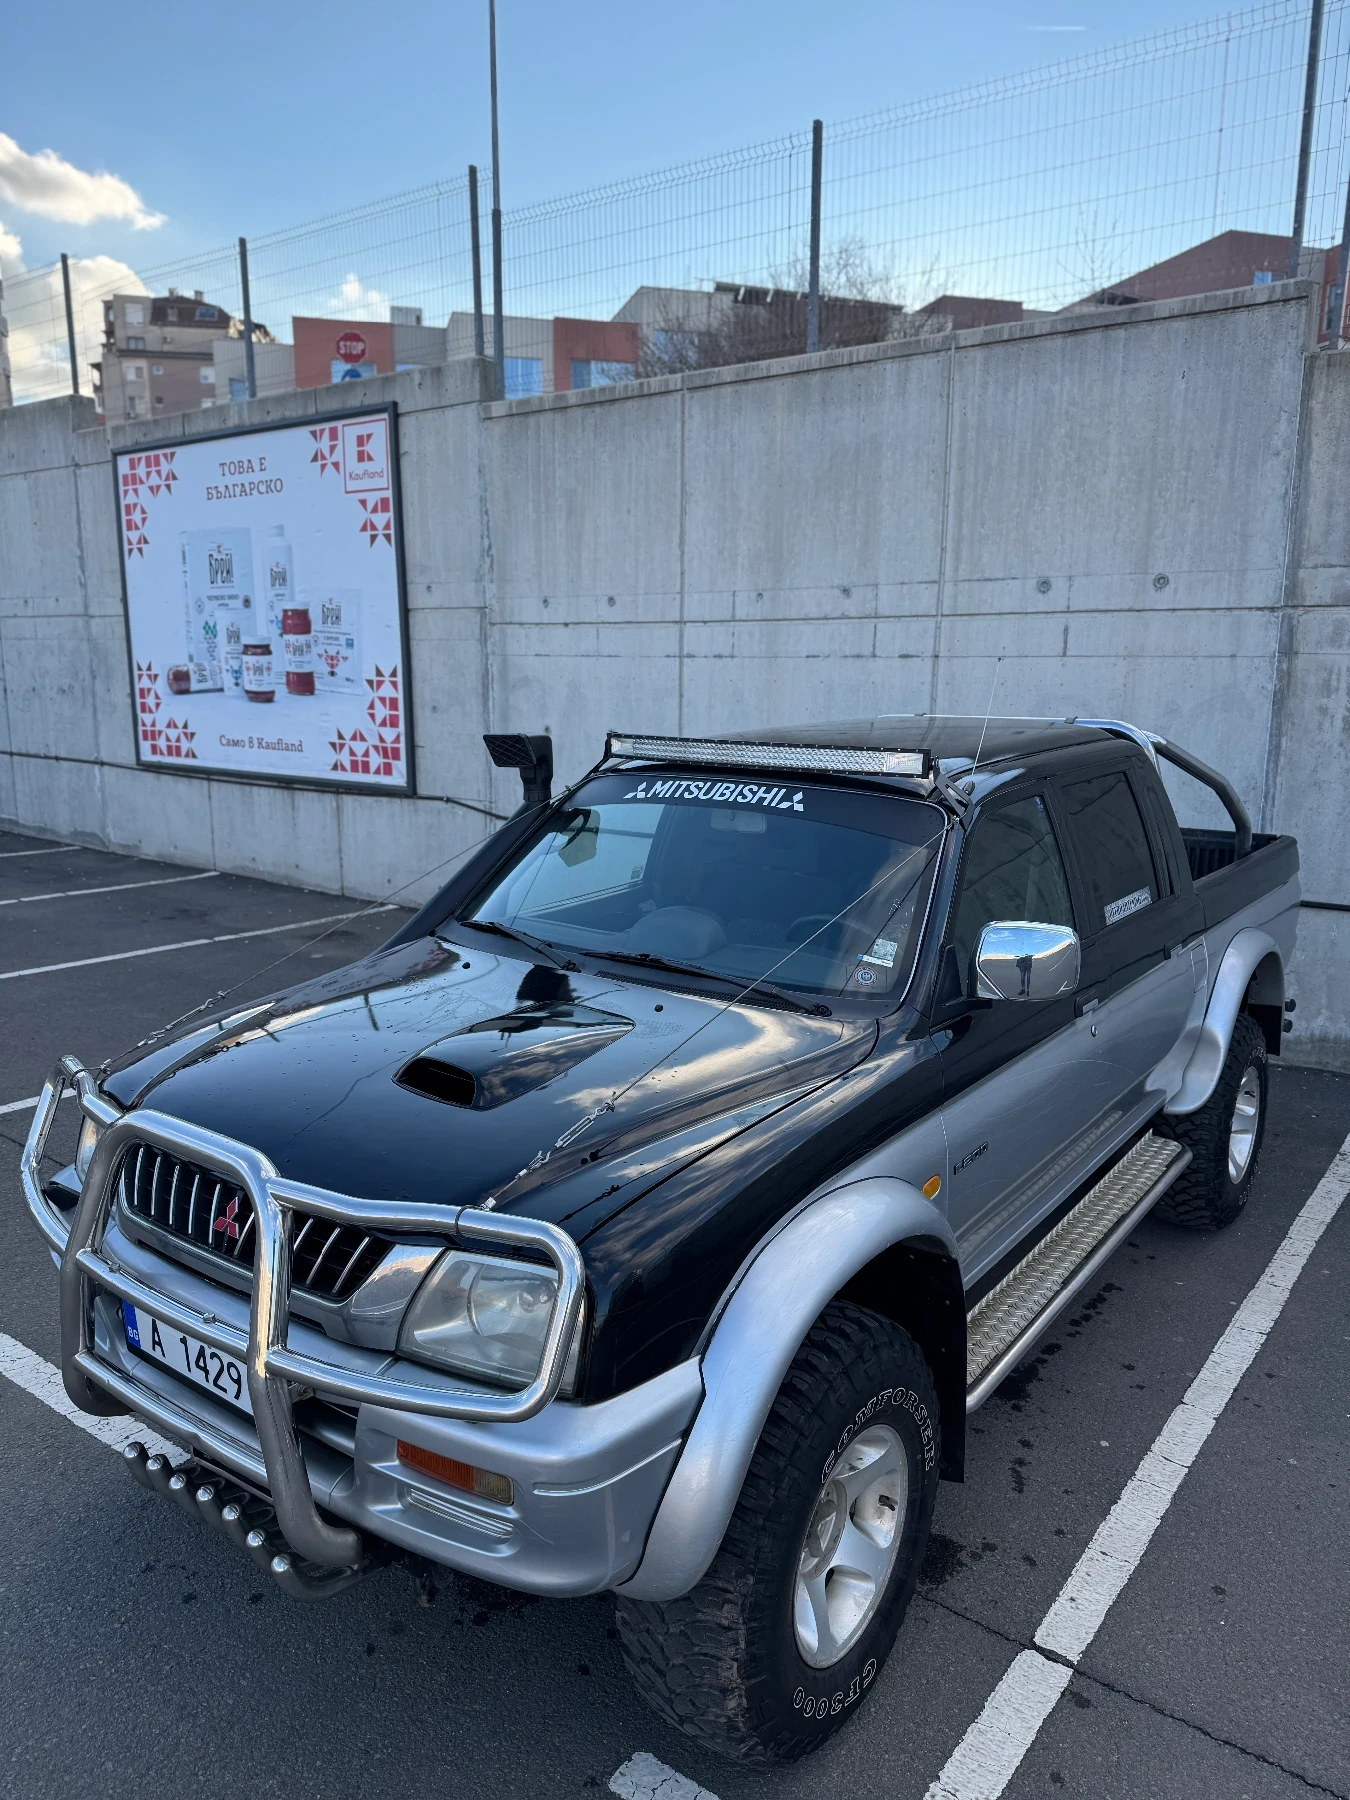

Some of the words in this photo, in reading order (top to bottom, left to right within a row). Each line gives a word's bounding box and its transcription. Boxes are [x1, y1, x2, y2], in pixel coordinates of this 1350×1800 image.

[339, 340, 365, 355] STOP
[219, 459, 255, 477] ТОВА
[258, 457, 267, 472] Е
[349, 468, 384, 481] Kaufland
[206, 477, 284, 500] БЪЛГАРСКО
[208, 552, 234, 584] Брей!
[219, 734, 246, 748] Само
[256, 737, 304, 753] Kaufland
[647, 780, 787, 807] MITSUBISHI
[127, 1325, 139, 1341] BG
[152, 1317, 166, 1358] A
[180, 1335, 241, 1401] 1429
[793, 1658, 877, 1719] CF3000
